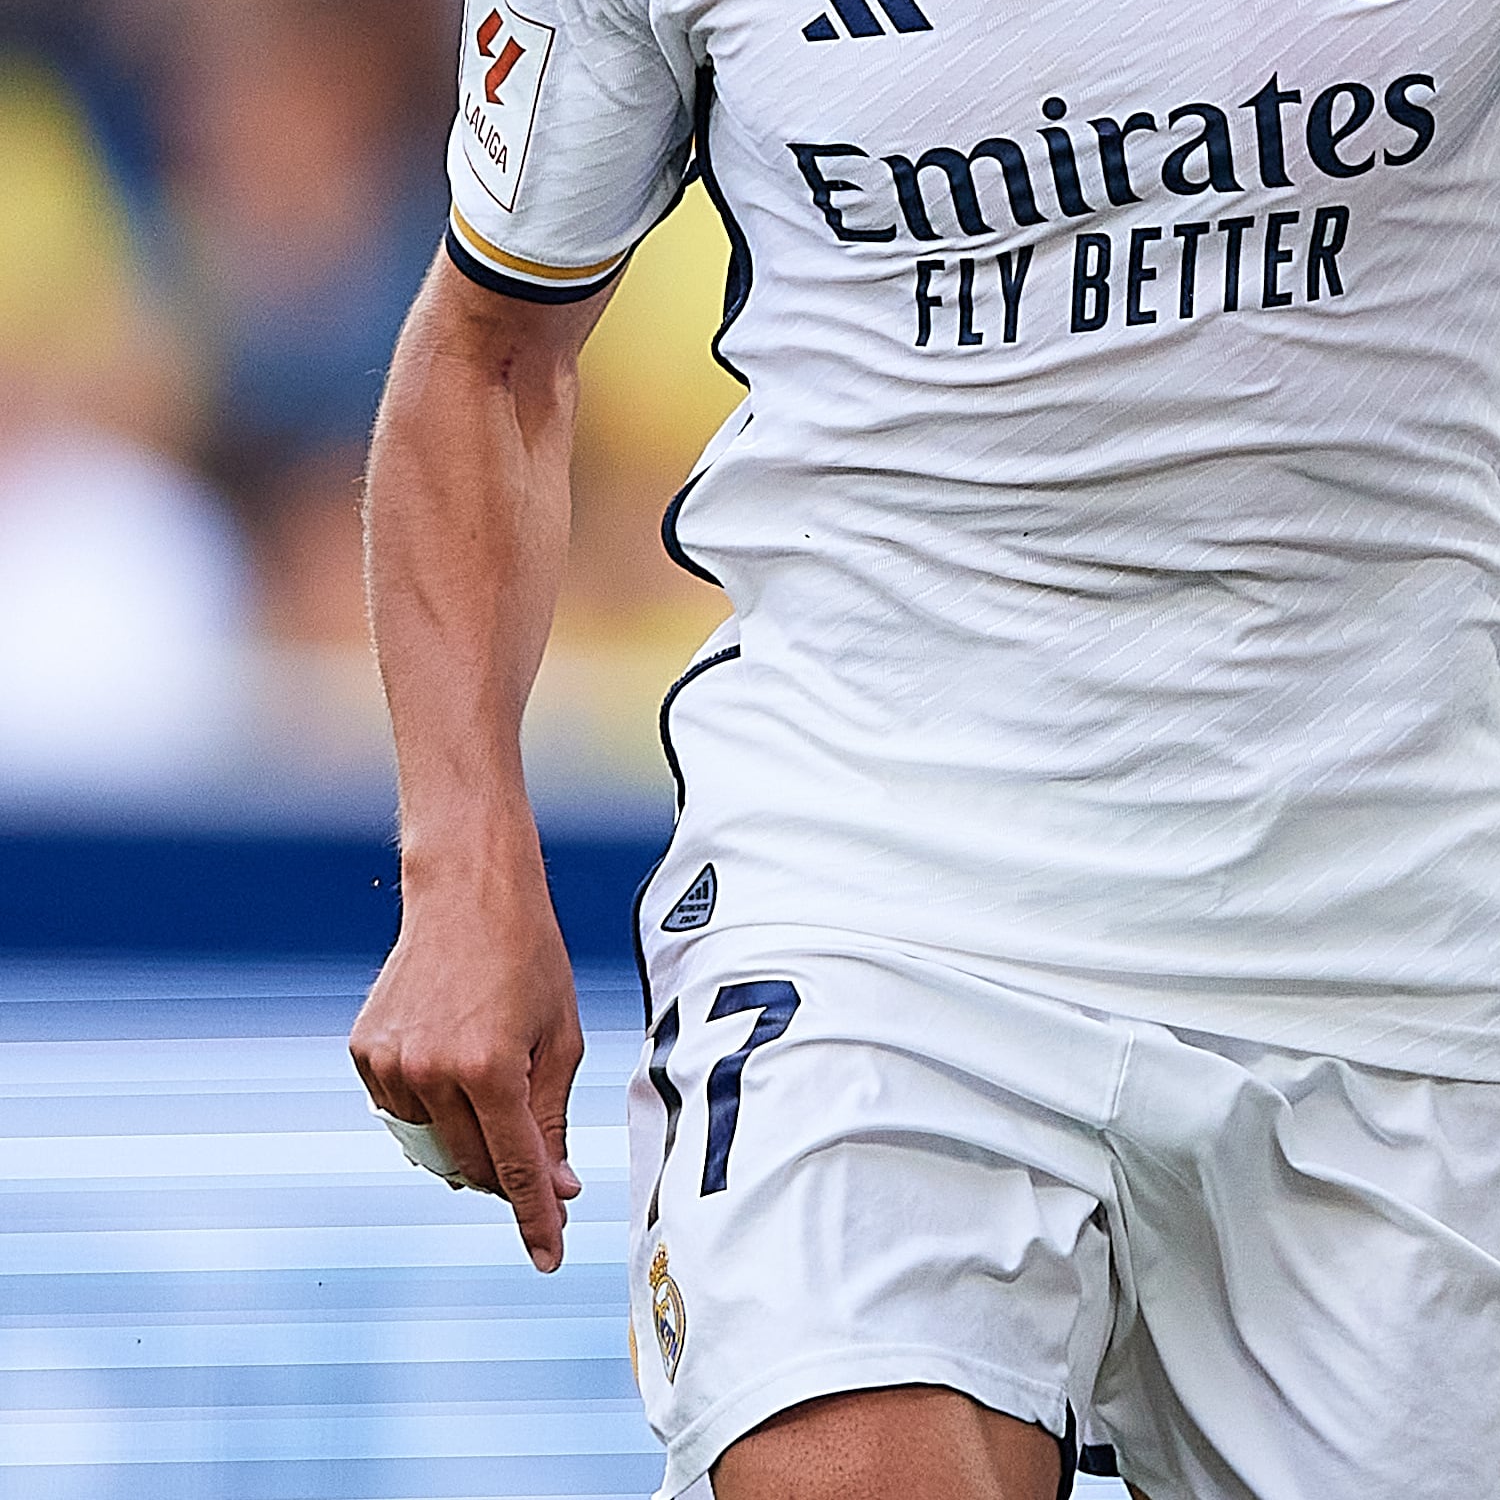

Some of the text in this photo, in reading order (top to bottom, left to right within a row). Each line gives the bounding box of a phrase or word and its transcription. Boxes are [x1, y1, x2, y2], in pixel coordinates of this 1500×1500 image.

[464, 91, 508, 174] LALIGA
[786, 71, 1437, 243] Emirates
[915, 205, 1348, 347] FLY BETTER
